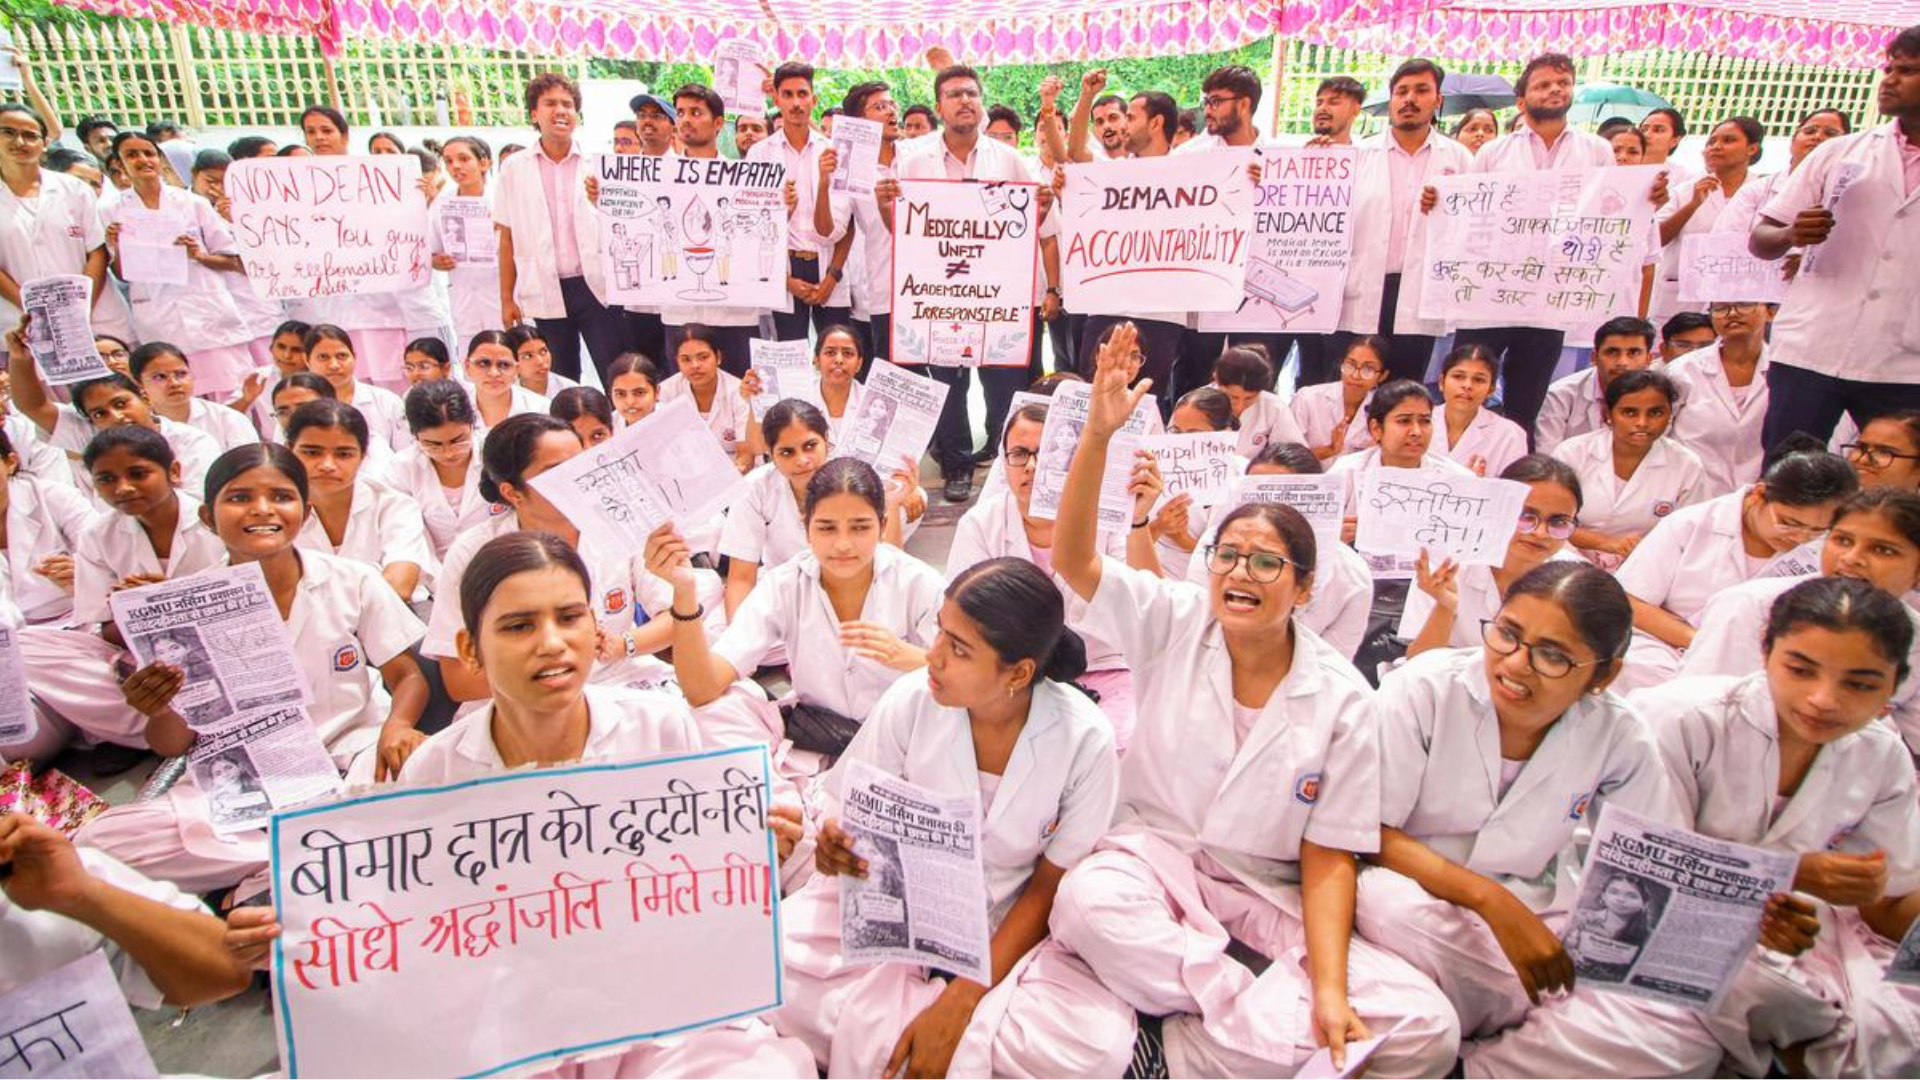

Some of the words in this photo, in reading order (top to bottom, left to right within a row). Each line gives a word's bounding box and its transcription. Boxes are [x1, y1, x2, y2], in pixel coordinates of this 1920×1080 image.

[601, 155, 662, 183] WHERE
[674, 158, 700, 185] IS
[705, 160, 786, 189] EMPATHY
[1264, 157, 1352, 180] MATTERS
[230, 164, 301, 204] NOW
[306, 163, 402, 206] DEAN
[1102, 184, 1218, 211] DEMAND
[1293, 184, 1352, 207] THAN
[1445, 182, 1498, 216] कुर्सी
[1500, 184, 1521, 212] है
[938, 240, 986, 260] UNFIT
[1279, 248, 1298, 257] not
[1311, 238, 1342, 248] leave
[1610, 239, 1634, 263] है
[900, 273, 1002, 299] ACADEMICALLY
[1370, 481, 1491, 517] इस्तीफा
[127, 602, 172, 620] KGMU
[849, 787, 884, 814] KGMU
[290, 829, 434, 904] बीमार
[540, 789, 602, 859] को
[702, 768, 767, 834] नहीं
[1610, 831, 1667, 861] KGMU
[1667, 852, 1711, 877] नर्सिंग
[1713, 868, 1759, 888] प्रशासन
[293, 901, 414, 990] सीधे
[420, 871, 613, 958] श्रद्धांजलि
